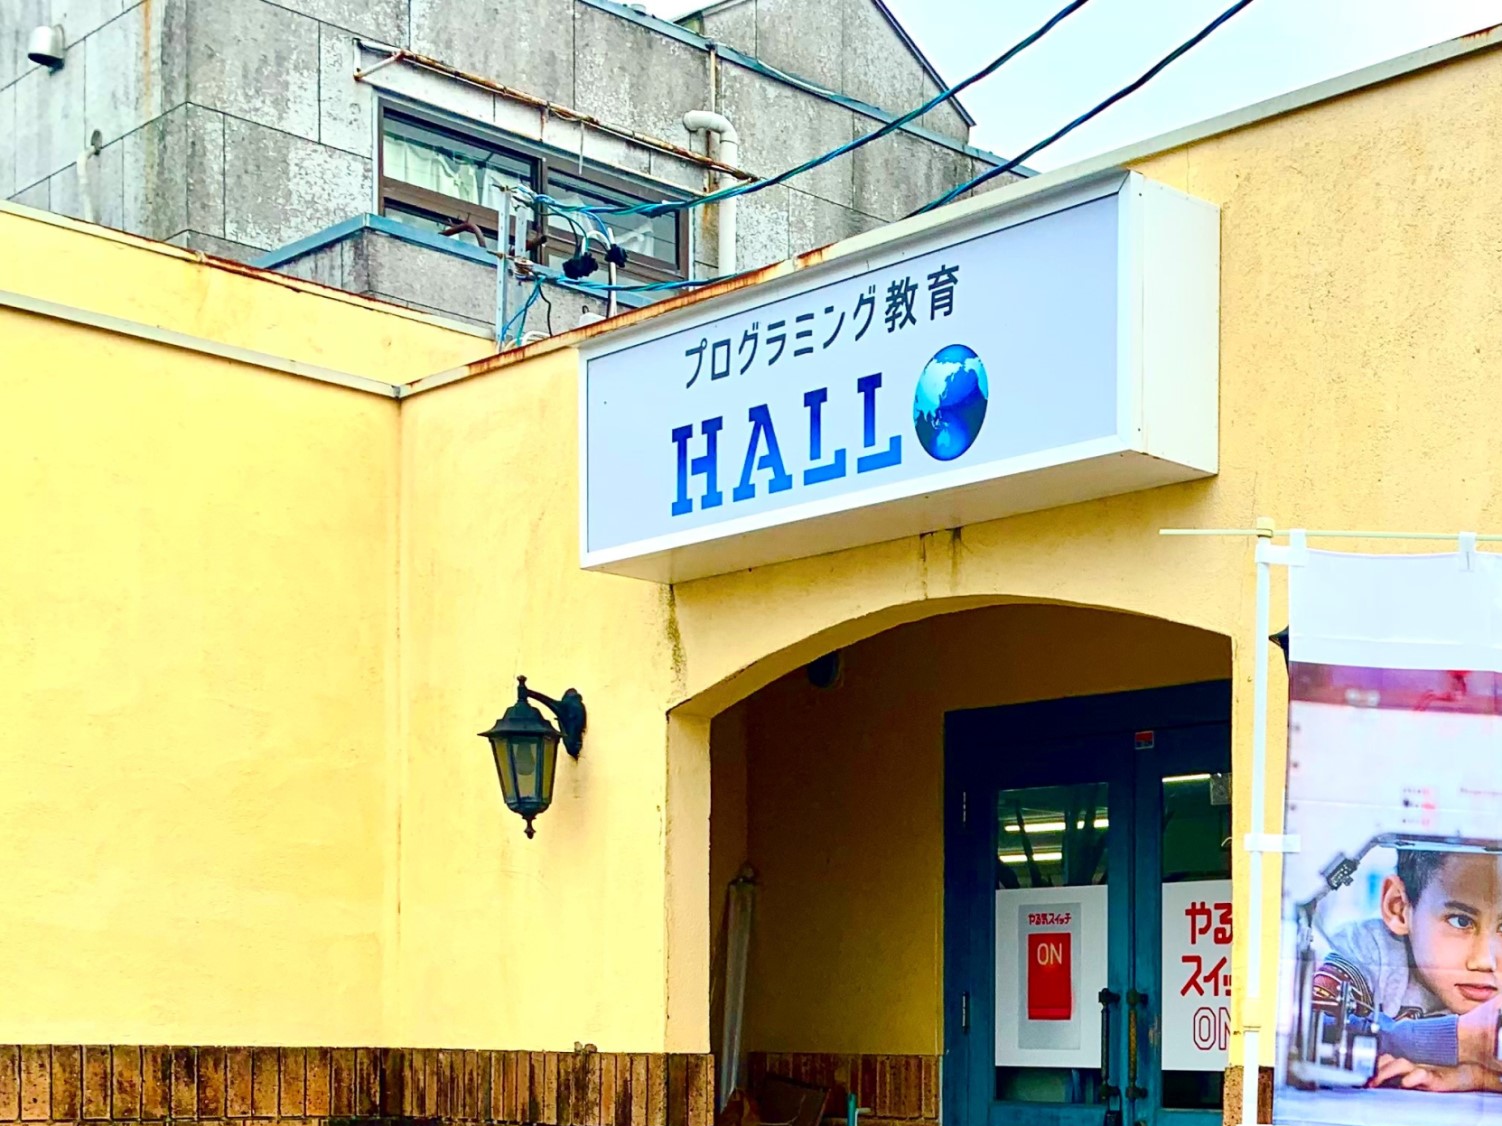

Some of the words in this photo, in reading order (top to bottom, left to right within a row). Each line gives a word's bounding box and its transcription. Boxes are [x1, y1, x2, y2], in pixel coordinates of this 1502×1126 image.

[685, 264, 960, 389] プログラミング教育
[1028, 912, 1072, 925] やる気スイッチ
[1037, 942, 1063, 966] ON
